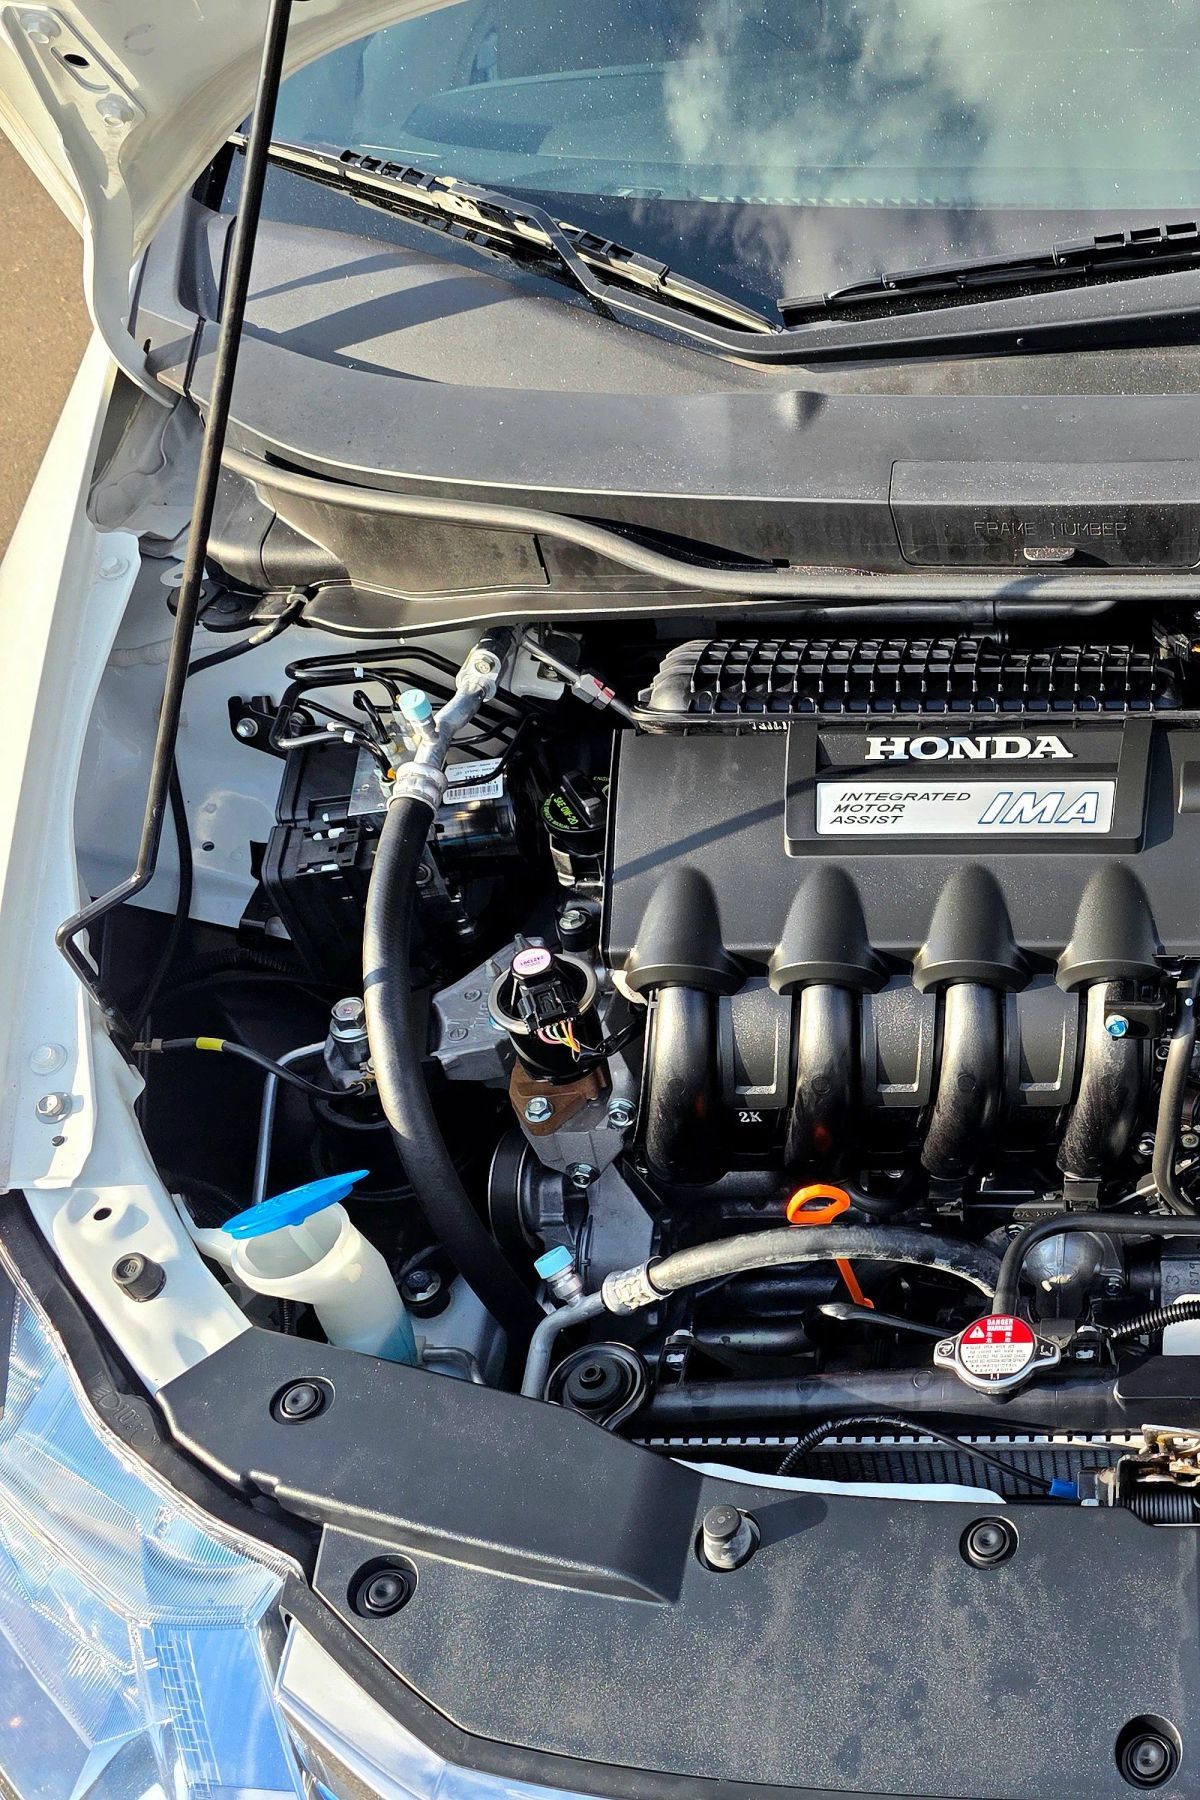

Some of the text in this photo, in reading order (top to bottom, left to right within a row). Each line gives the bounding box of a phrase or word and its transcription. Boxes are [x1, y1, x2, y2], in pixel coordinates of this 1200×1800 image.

[973, 521, 1127, 536] FRAME NUMBER
[865, 735, 1075, 760] HONDA
[839, 792, 972, 802] INTEGRATED
[833, 804, 906, 813] MOTOR
[978, 791, 1100, 825] IMA
[830, 815, 904, 825] ASSIST
[738, 1111, 763, 1123] 2K
